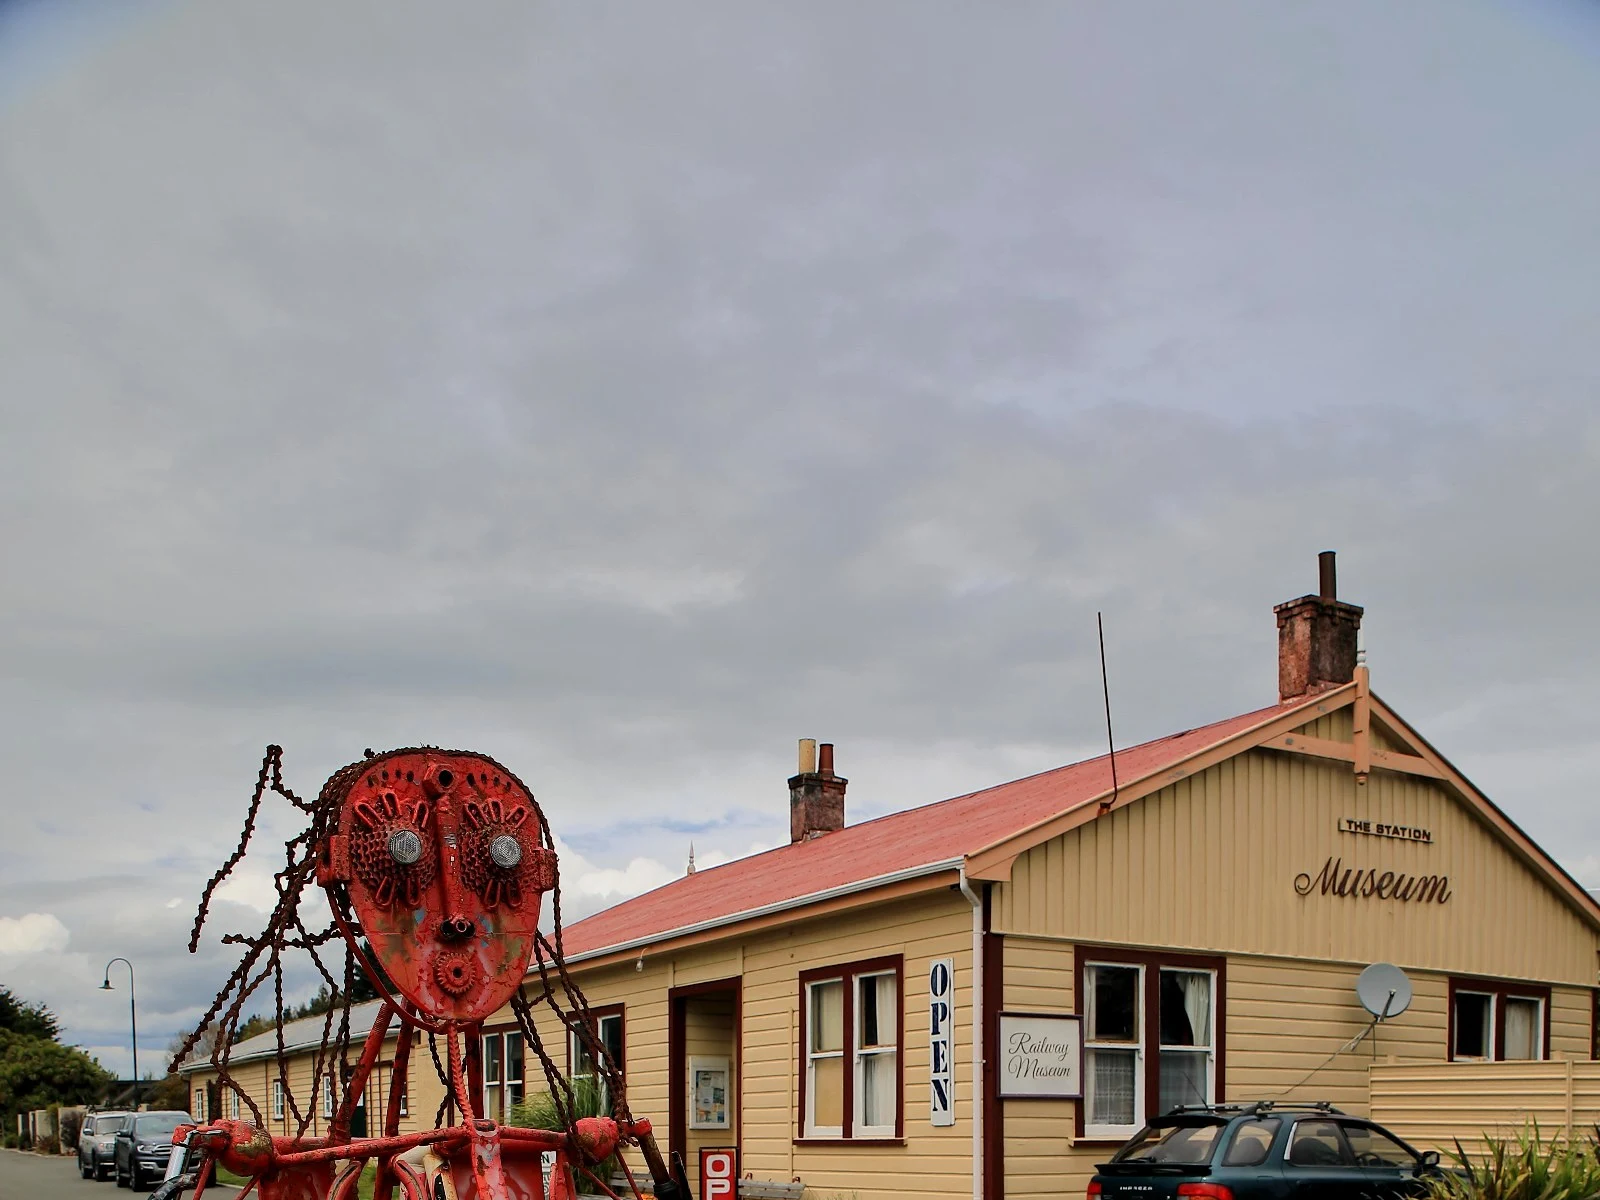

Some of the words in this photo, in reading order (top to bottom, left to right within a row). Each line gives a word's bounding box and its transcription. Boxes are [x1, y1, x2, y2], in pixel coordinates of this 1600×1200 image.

[1346, 819, 1371, 832] THE
[1376, 824, 1431, 841] STATION
[1294, 856, 1452, 904] Museum
[930, 963, 949, 1112] OPEN
[1008, 1032, 1069, 1062] Railway
[1008, 1055, 1071, 1079] Museum
